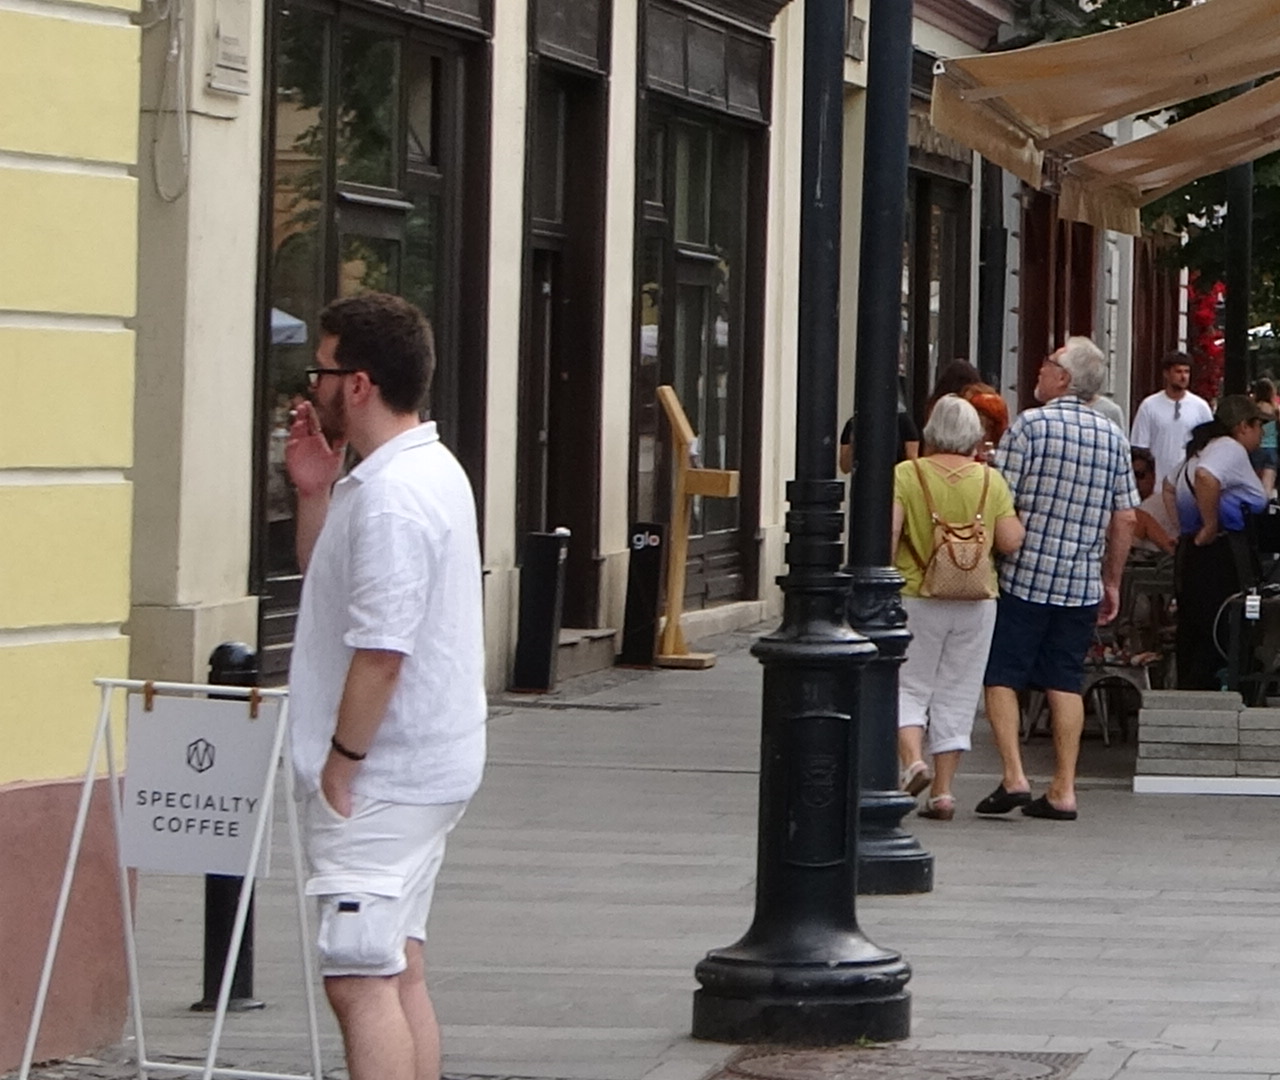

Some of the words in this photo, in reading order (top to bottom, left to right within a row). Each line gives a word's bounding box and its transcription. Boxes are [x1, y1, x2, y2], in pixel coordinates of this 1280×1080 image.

[632, 531, 660, 550] glo
[136, 789, 258, 814] SPECIALTY
[152, 815, 240, 838] COFFEE
